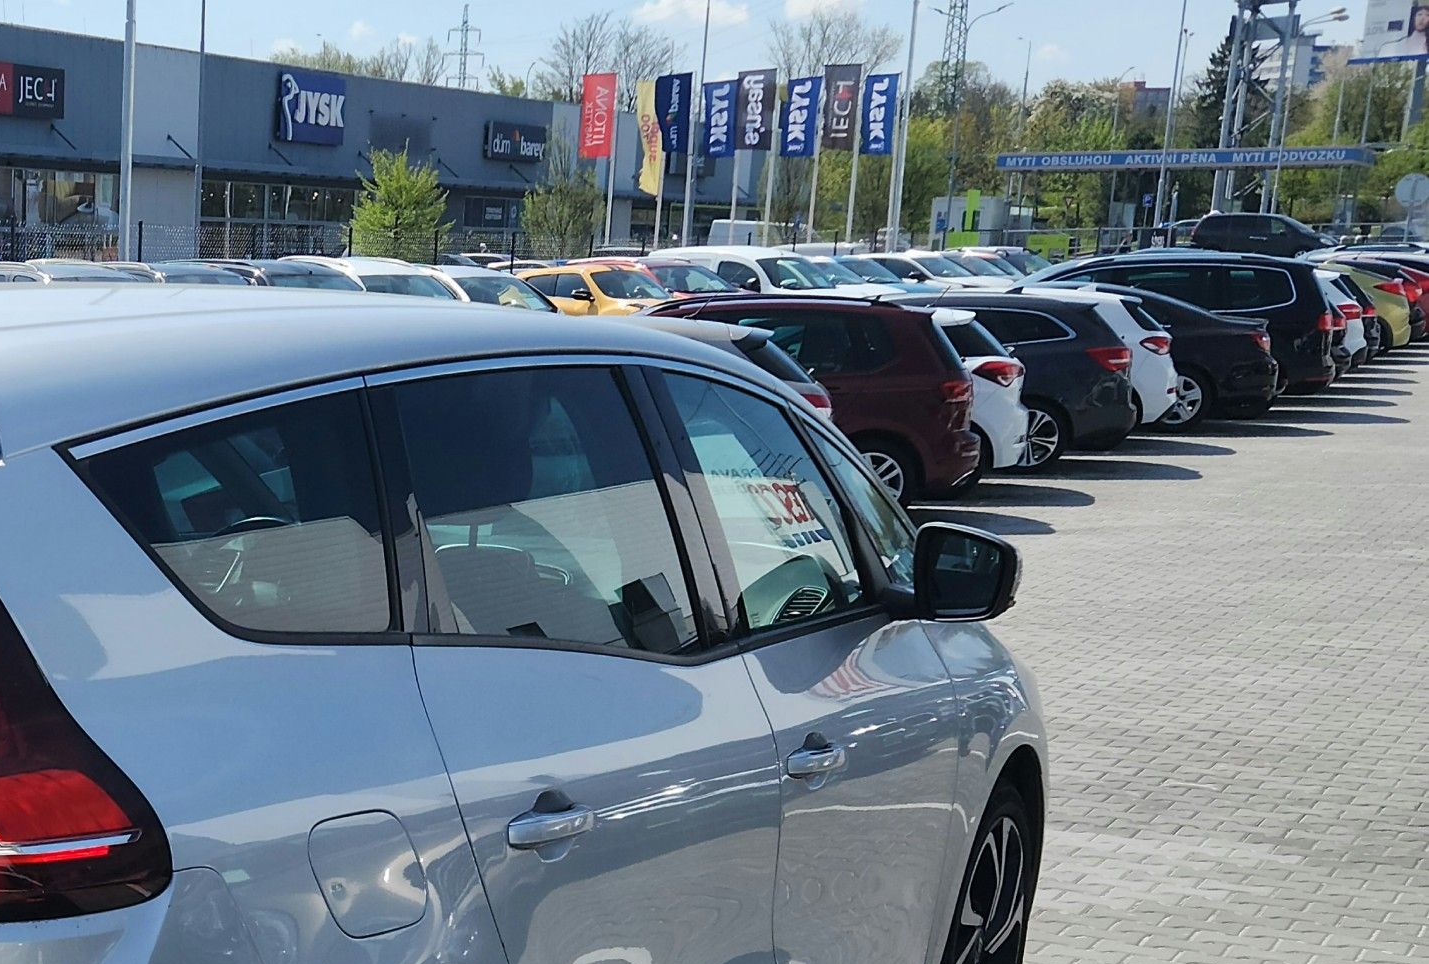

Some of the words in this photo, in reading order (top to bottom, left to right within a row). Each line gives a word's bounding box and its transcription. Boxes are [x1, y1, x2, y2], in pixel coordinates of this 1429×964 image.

[295, 92, 344, 128] JYSK
[1041, 155, 1112, 166] OBSLUHOU
[1269, 150, 1346, 162] PODVOZKU
